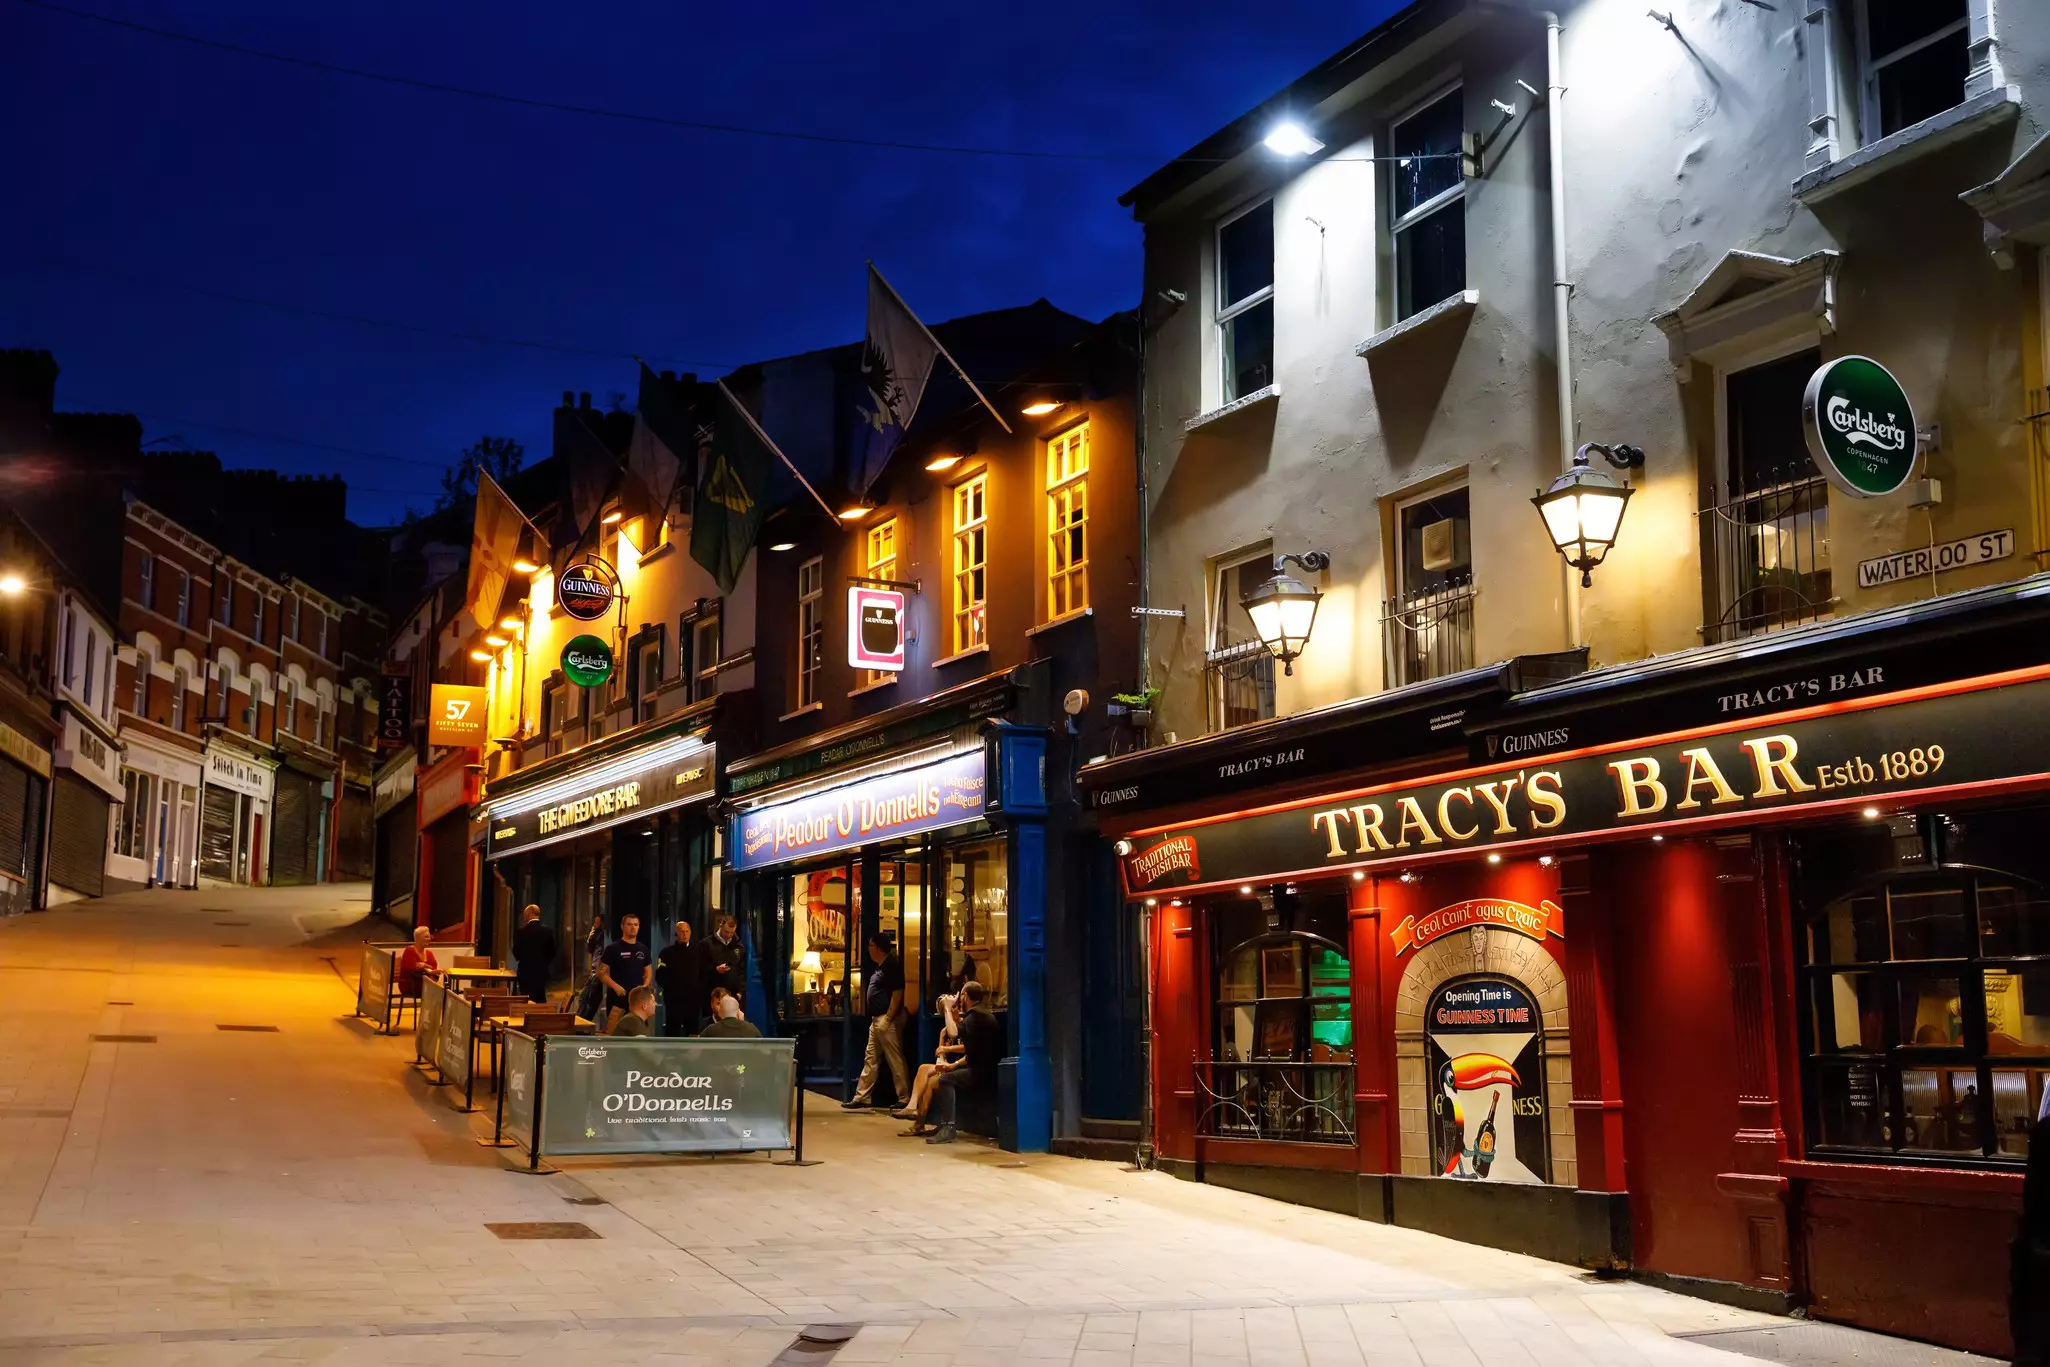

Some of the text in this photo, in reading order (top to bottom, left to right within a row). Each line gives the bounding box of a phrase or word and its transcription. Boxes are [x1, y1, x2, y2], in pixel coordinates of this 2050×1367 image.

[1827, 396, 1906, 450] Carlsberg
[1846, 447, 1889, 465] COPENHAGEN
[1863, 532, 2008, 584] WATERLOO ST
[562, 578, 610, 597] GUINNESS
[864, 616, 894, 625] GUINNESS
[567, 651, 608, 669] Carlsberg
[1718, 666, 1885, 712] TRACY'S BAR
[384, 677, 404, 738] TATTOO
[445, 699, 471, 720] 57
[436, 720, 479, 729] FIFTY SEVEN
[1503, 727, 1569, 754] GUINNESS
[820, 745, 845, 764] PEADAR
[1218, 748, 1305, 778] TRACY'S BAR
[213, 755, 262, 787] Stitch in Time
[1100, 785, 1139, 805] GUINNESS
[1313, 734, 1945, 858] TRACY'S BAR Estb. 1889
[538, 781, 640, 834] THE GWEEDORE BAR
[774, 777, 940, 856] Peadar O'Donnell's
[1132, 838, 1193, 878] TRADITIONAL
[1145, 853, 1193, 884] IRISH BAR
[1442, 903, 1473, 927] Caint
[1475, 904, 1505, 921] agus
[1445, 987, 1512, 1005] Opening Time is
[1437, 1007, 1529, 1024] GUINNESS TIME
[578, 1047, 607, 1059] Carlsberg
[626, 1070, 713, 1088] Peadar
[602, 1093, 733, 1112] O'Donnells
[743, 1129, 752, 1138] 57
